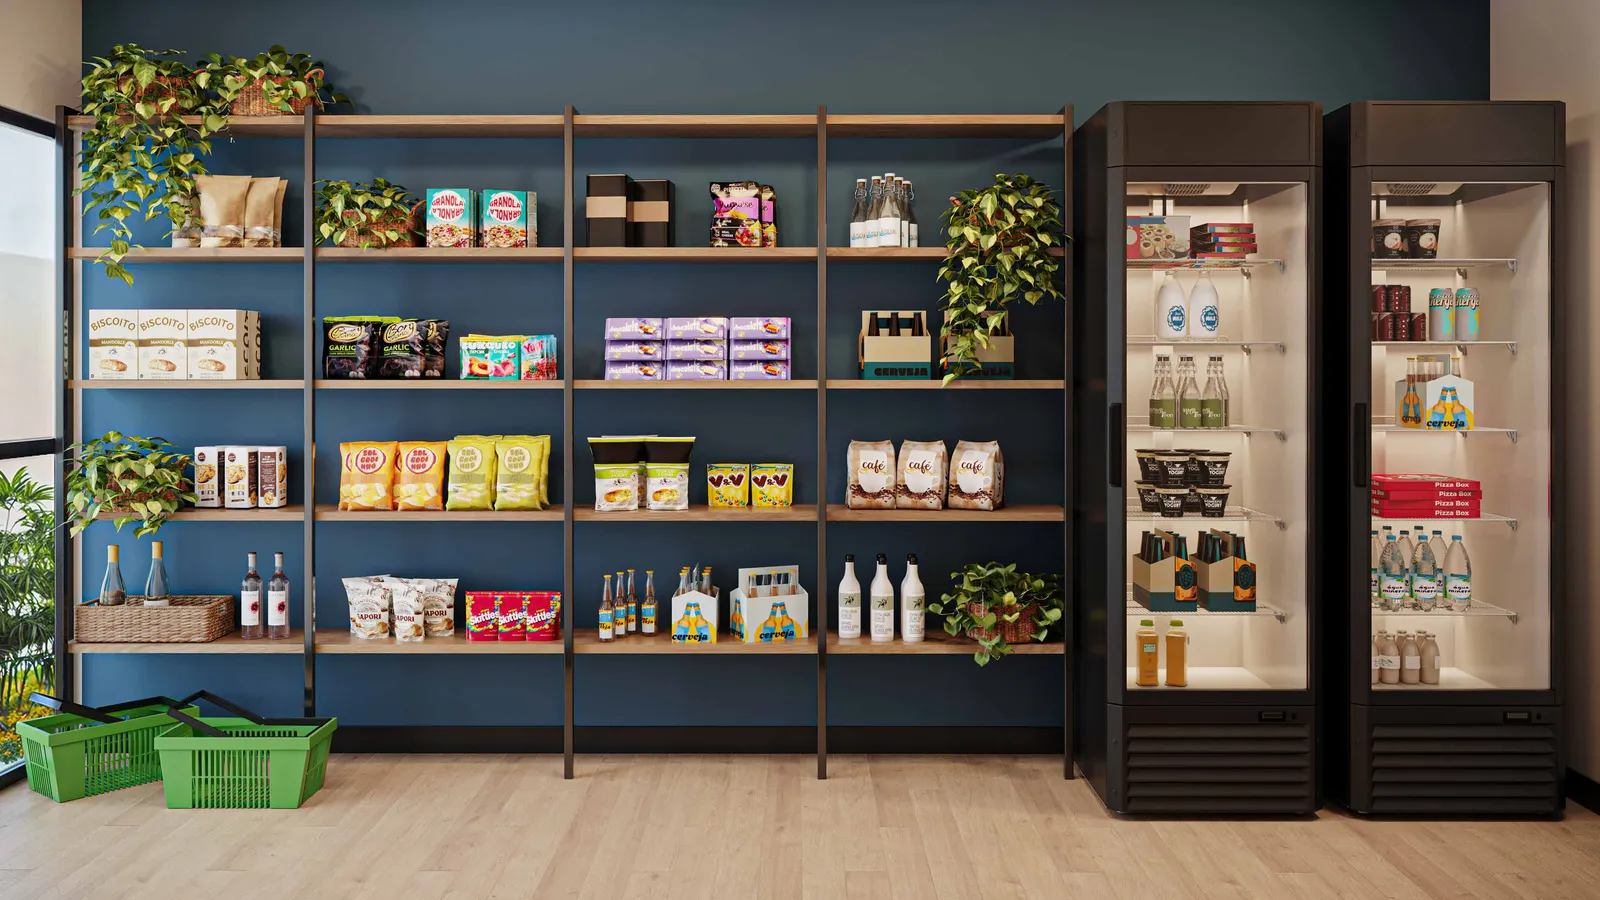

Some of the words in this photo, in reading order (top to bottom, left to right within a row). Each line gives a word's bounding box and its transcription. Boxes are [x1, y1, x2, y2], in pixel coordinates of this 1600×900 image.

[432, 194, 464, 206] GRANOLA
[489, 196, 520, 208] GRANOLA
[91, 317, 136, 332] BISCOITO
[140, 317, 185, 332] BISCOITO
[189, 317, 234, 332] BISCOITO
[874, 368, 928, 376] CERVEJA
[1427, 419, 1465, 428] cerveja
[862, 460, 885, 473] café
[909, 460, 932, 474] café
[961, 460, 984, 474] café
[470, 611, 499, 625] Skittles
[499, 611, 527, 625] Skittles
[526, 611, 556, 625] Skittles
[672, 632, 707, 642] cerveja
[760, 630, 794, 640] cerveja
